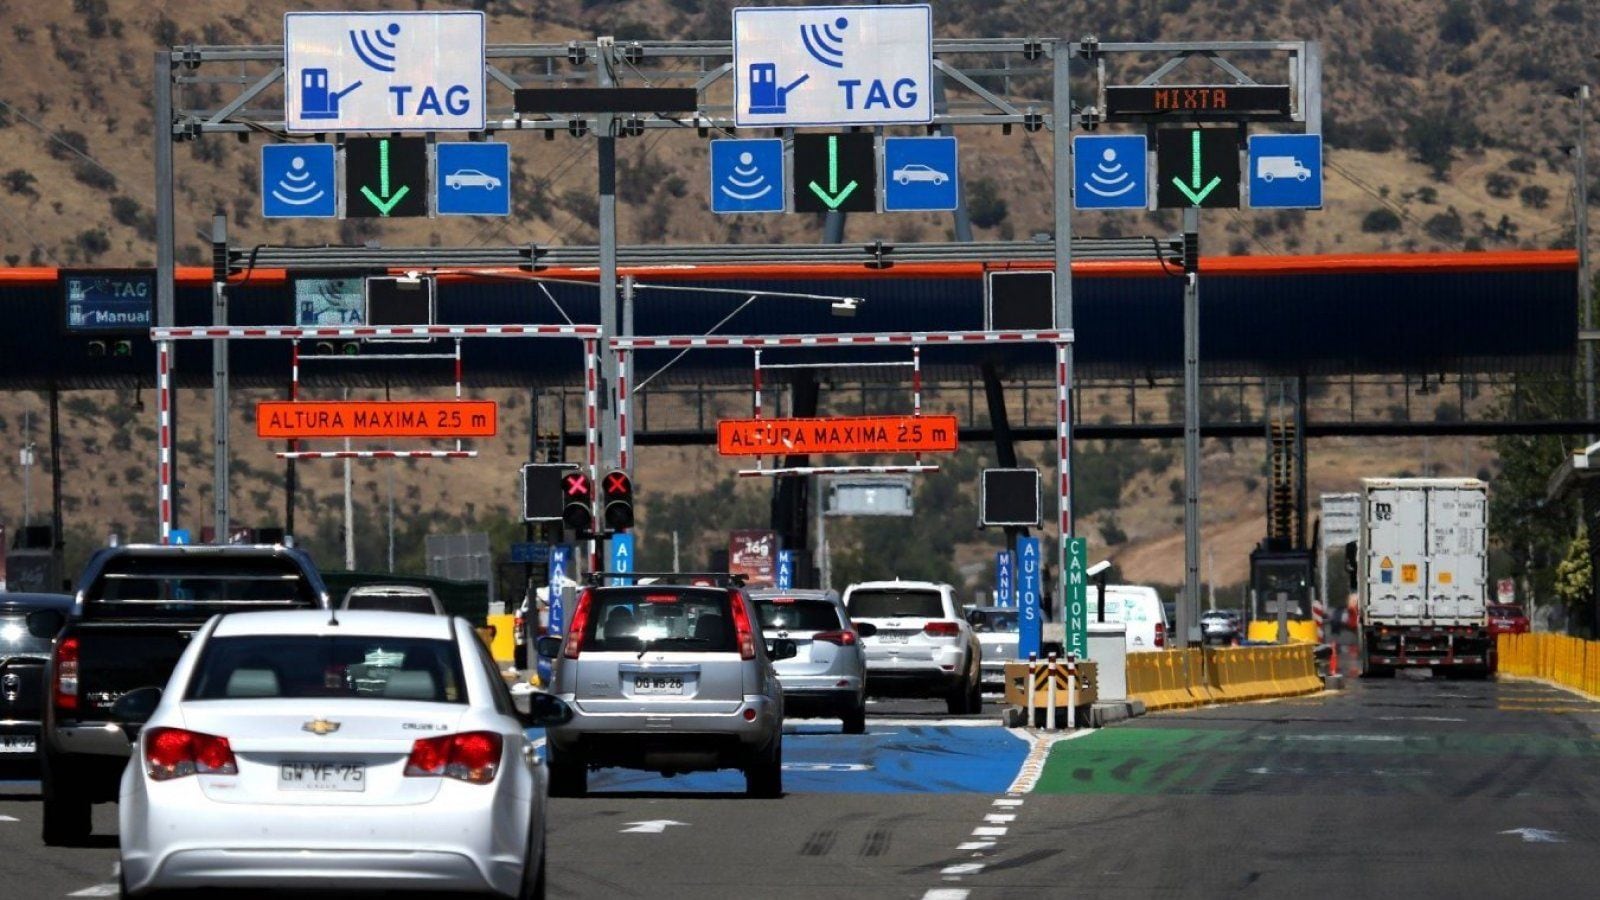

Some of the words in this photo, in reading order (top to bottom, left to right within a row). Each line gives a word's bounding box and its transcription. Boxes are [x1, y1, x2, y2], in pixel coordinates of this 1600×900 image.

[389, 85, 470, 116] TAG
[838, 79, 917, 109] TAG
[1154, 88, 1227, 110] MIXTA
[111, 282, 147, 298] TAG
[95, 309, 150, 323] Manual
[270, 411, 344, 428] ALTURA
[353, 409, 428, 428] MAXIMA
[471, 414, 487, 428] m
[731, 428, 806, 446] ALTURA
[814, 424, 889, 444] MAXIMA
[932, 428, 947, 442] m
[551, 551, 563, 621] MANUAL
[1023, 542, 1035, 620] AUTOS
[1070, 541, 1082, 661] CAMIONES
